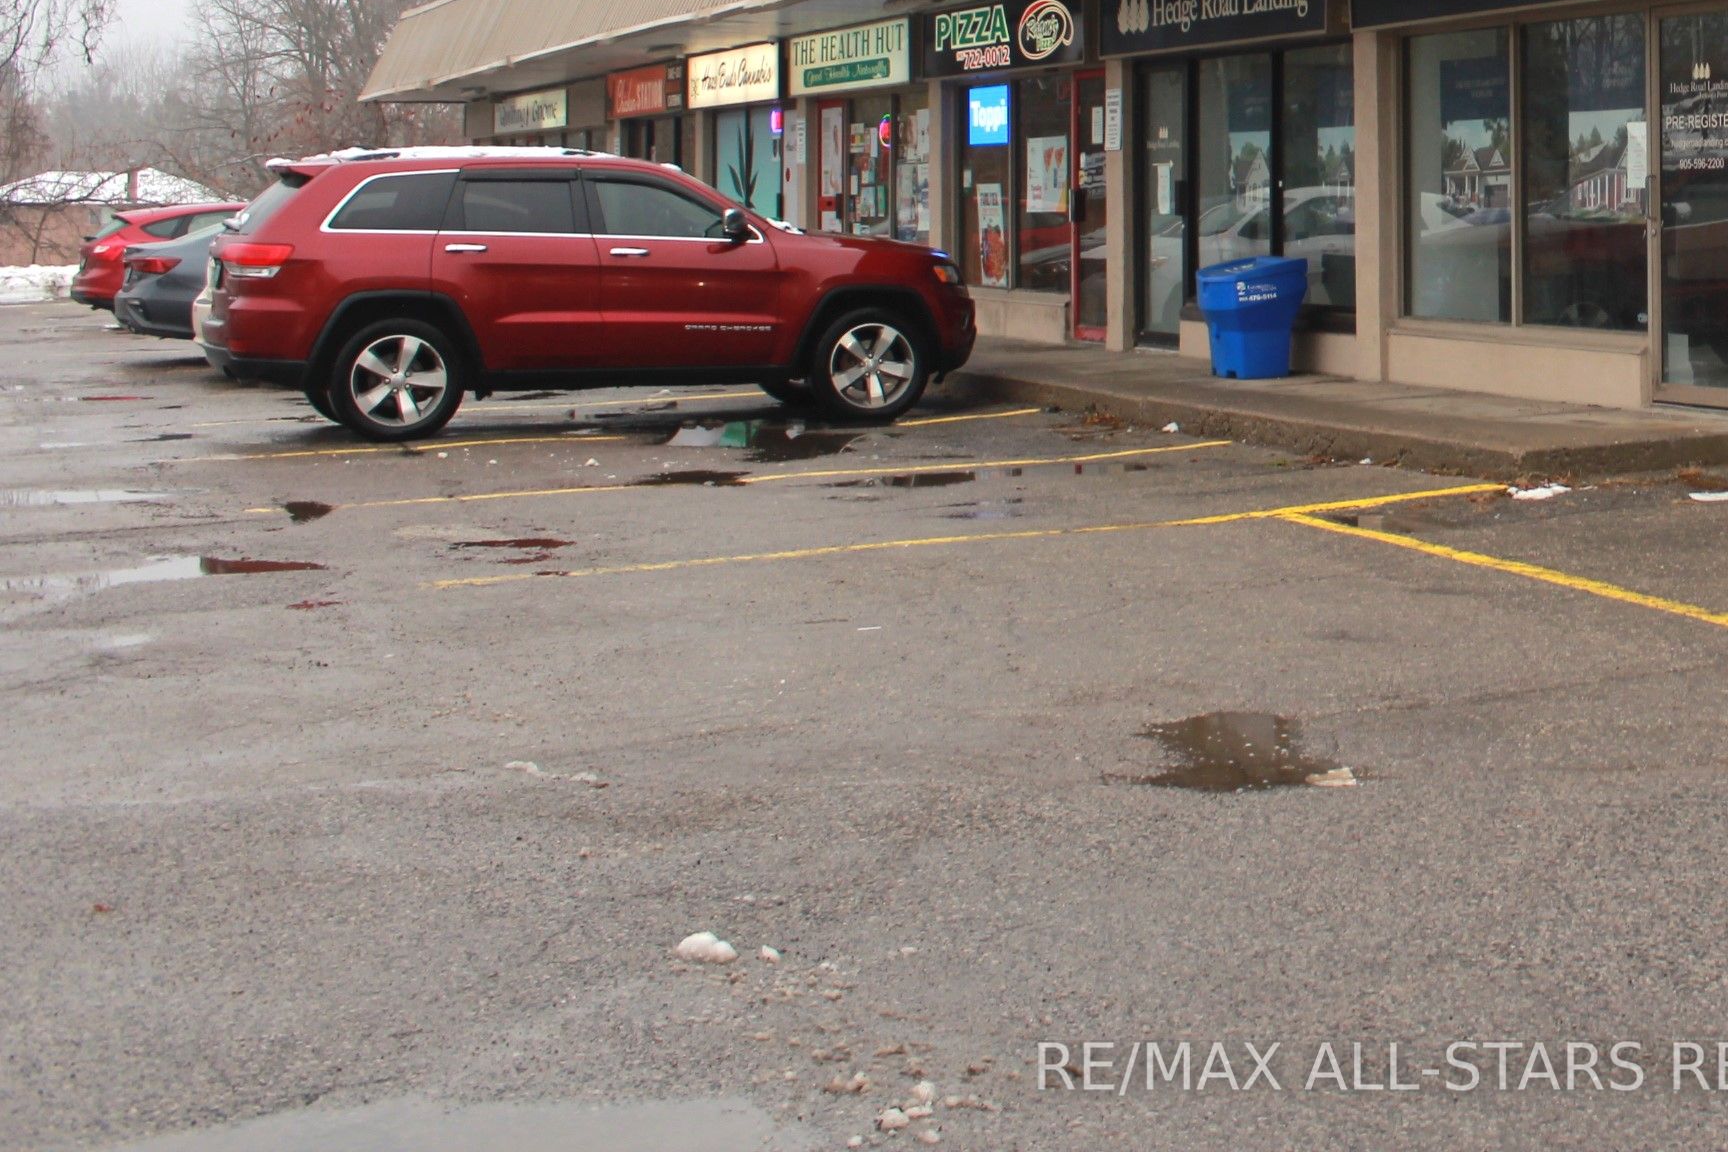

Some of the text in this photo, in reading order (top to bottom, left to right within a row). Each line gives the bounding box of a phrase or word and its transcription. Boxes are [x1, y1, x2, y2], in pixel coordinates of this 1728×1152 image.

[935, 4, 1010, 52] PIZZA
[793, 23, 904, 66] THE HEALTH HUT
[964, 45, 1011, 70] 722-0012
[738, 56, 772, 88] Cannabis
[1669, 82, 1690, 95] Hedge
[1690, 80, 1707, 92] Road
[1679, 157, 1725, 170] 905-596-2200
